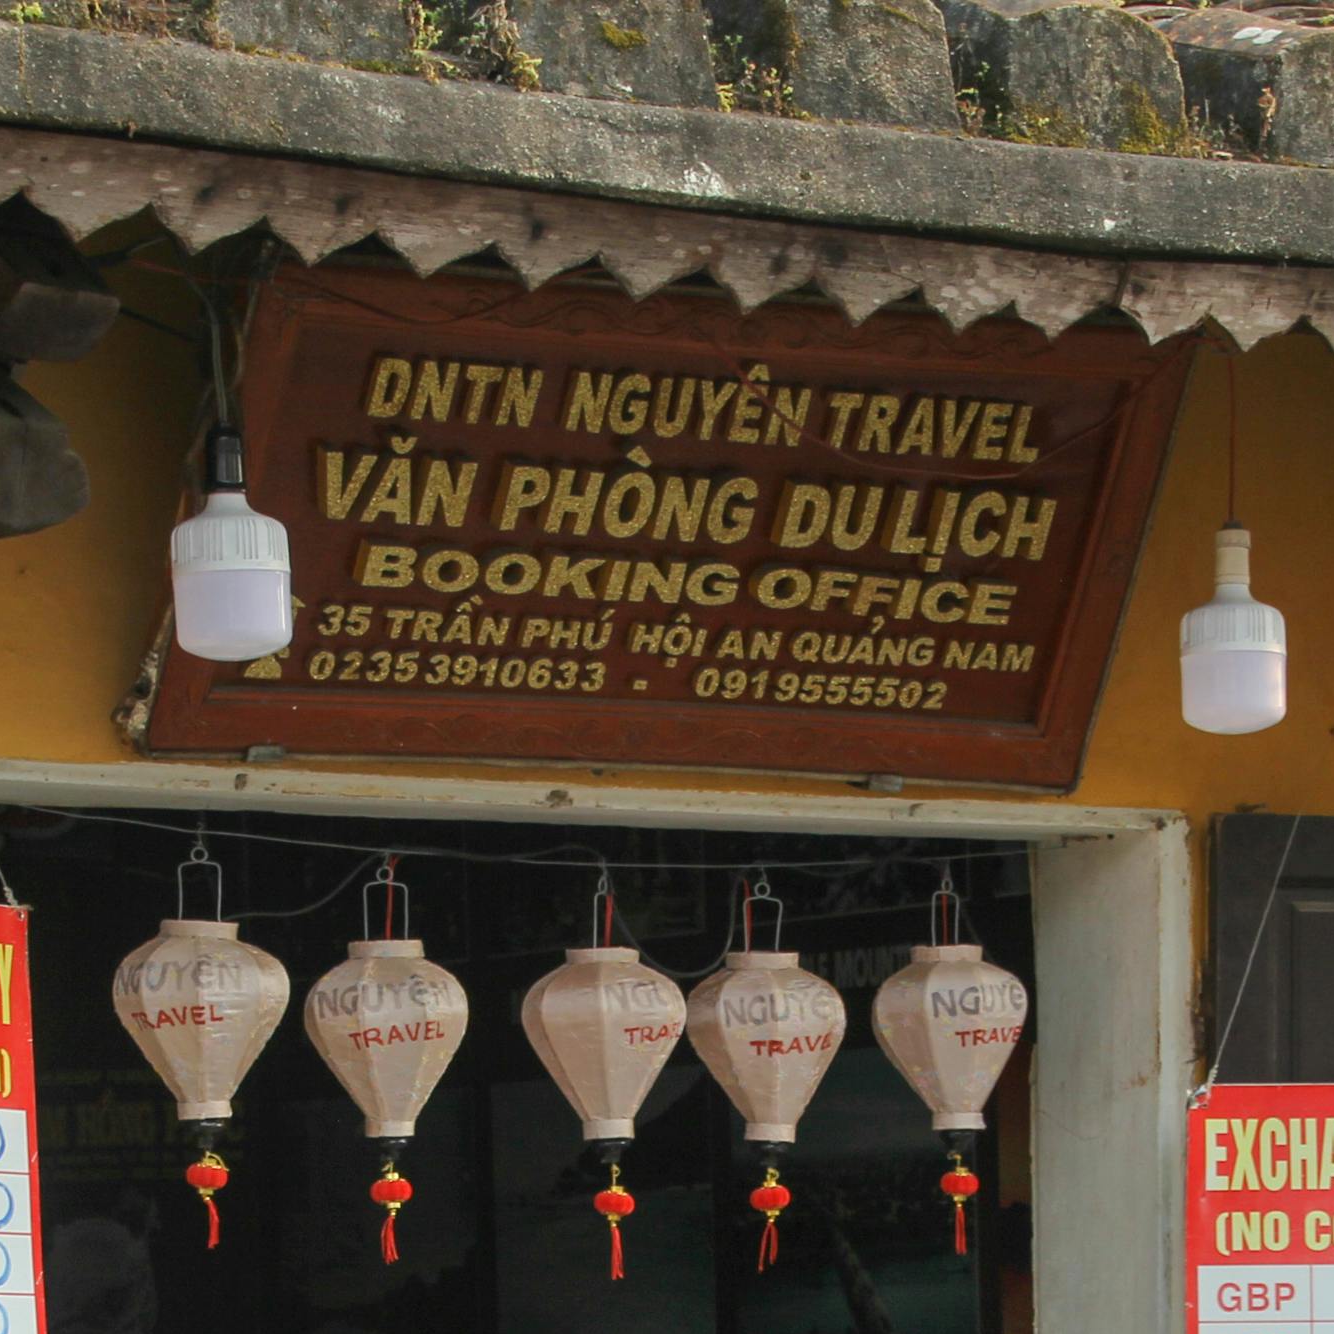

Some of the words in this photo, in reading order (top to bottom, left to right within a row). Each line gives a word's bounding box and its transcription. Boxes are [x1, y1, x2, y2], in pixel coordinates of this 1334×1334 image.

[367, 356, 543, 427] DNTN
[565, 363, 812, 447] NGUYÊN
[829, 391, 1040, 464] TRAVEL
[323, 435, 479, 528] VĂN
[499, 445, 759, 544] PHÒNG
[779, 483, 884, 551] DU
[888, 488, 1057, 573] LỊCH
[360, 544, 741, 607] BOOKING
[756, 567, 1018, 626] OFFICE
[317, 604, 373, 638] 35
[387, 594, 510, 647] TRẦN
[520, 609, 615, 652] PHÚ
[630, 613, 708, 669] HỘI
[716, 629, 783, 661] AN
[791, 615, 935, 667] QUẢNG
[943, 639, 1035, 673] NAM
[695, 667, 948, 711] 0919555502
[131, 1005, 225, 1032] TRAVEL
[349, 1020, 446, 1050] TRAVEL
[954, 1025, 1023, 1048] TRAVE
[1215, 1210, 1291, 1256] (NO
[1217, 1282, 1296, 1312] GBP
